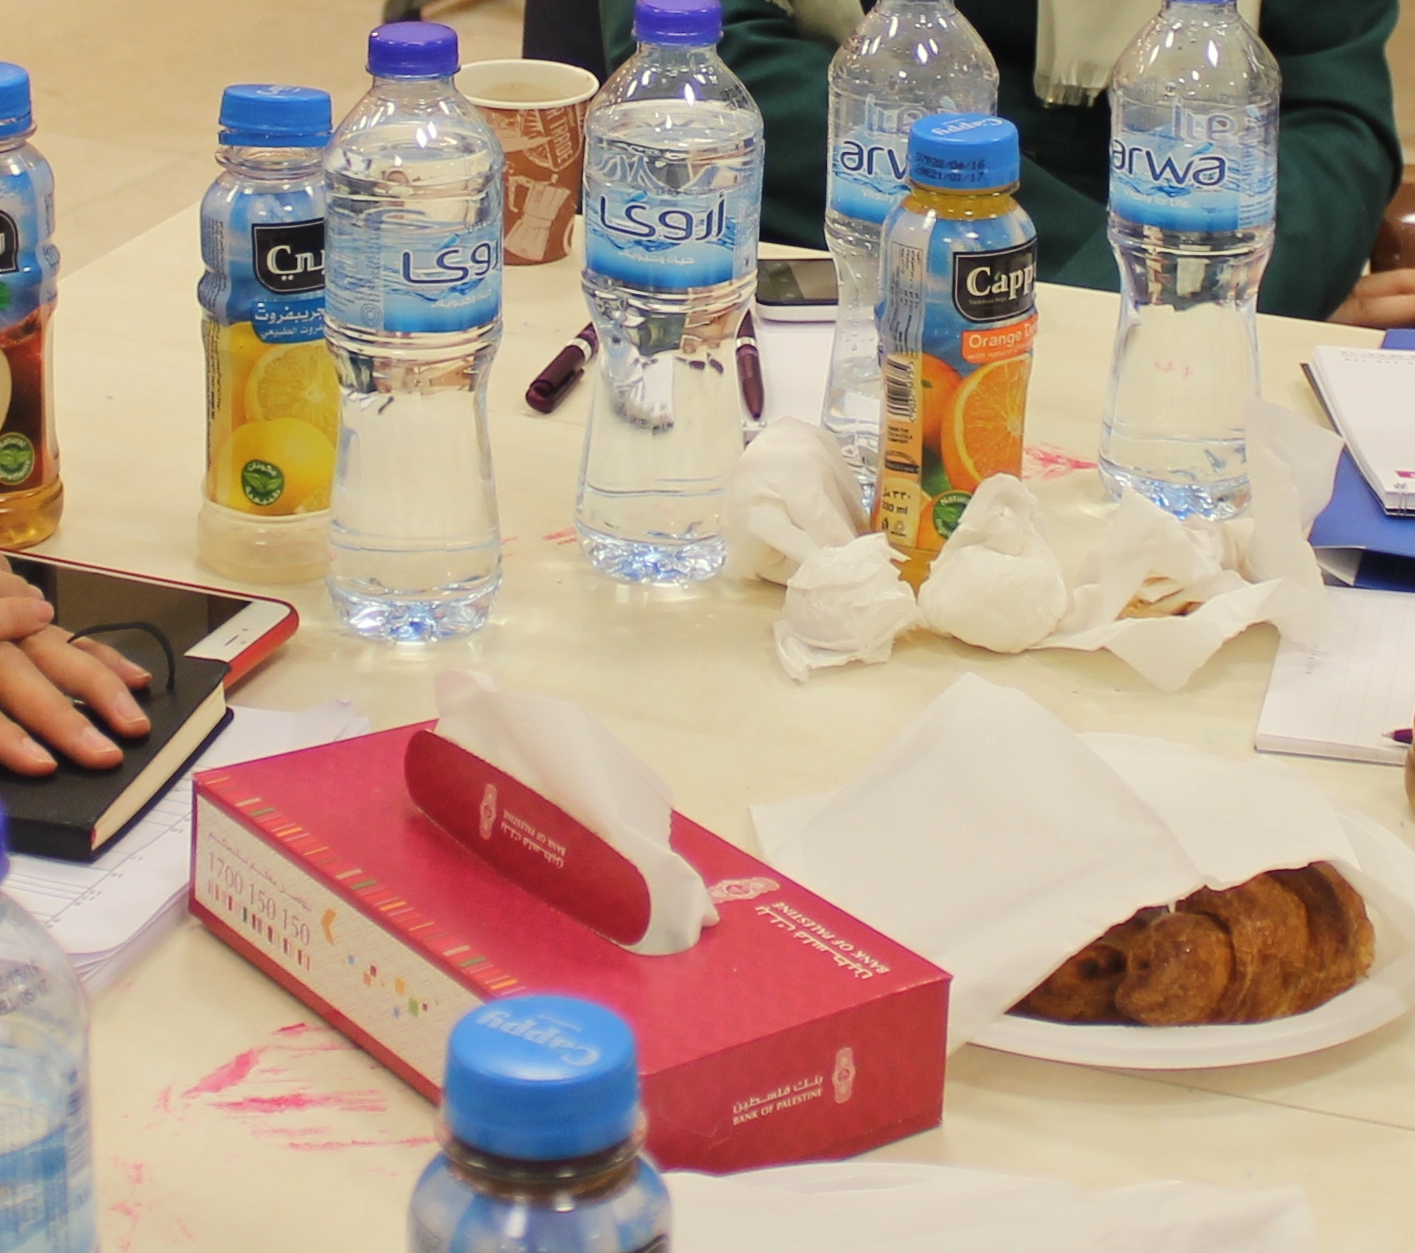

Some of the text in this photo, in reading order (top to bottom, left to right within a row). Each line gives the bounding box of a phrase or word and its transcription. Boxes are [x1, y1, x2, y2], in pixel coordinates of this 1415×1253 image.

[549, 119, 573, 165] TRADE
[1112, 139, 1226, 187] arwa
[600, 191, 727, 242] أروى
[966, 262, 1036, 300] Capp
[969, 330, 1023, 351] Orange
[209, 852, 243, 895] 1700
[249, 884, 276, 921] 150
[283, 909, 310, 946] 150
[771, 901, 890, 974] BANK OF PALESTINE
[476, 1010, 601, 1066] Cappy
[732, 1087, 823, 1126] BANK OF PALESTINE
